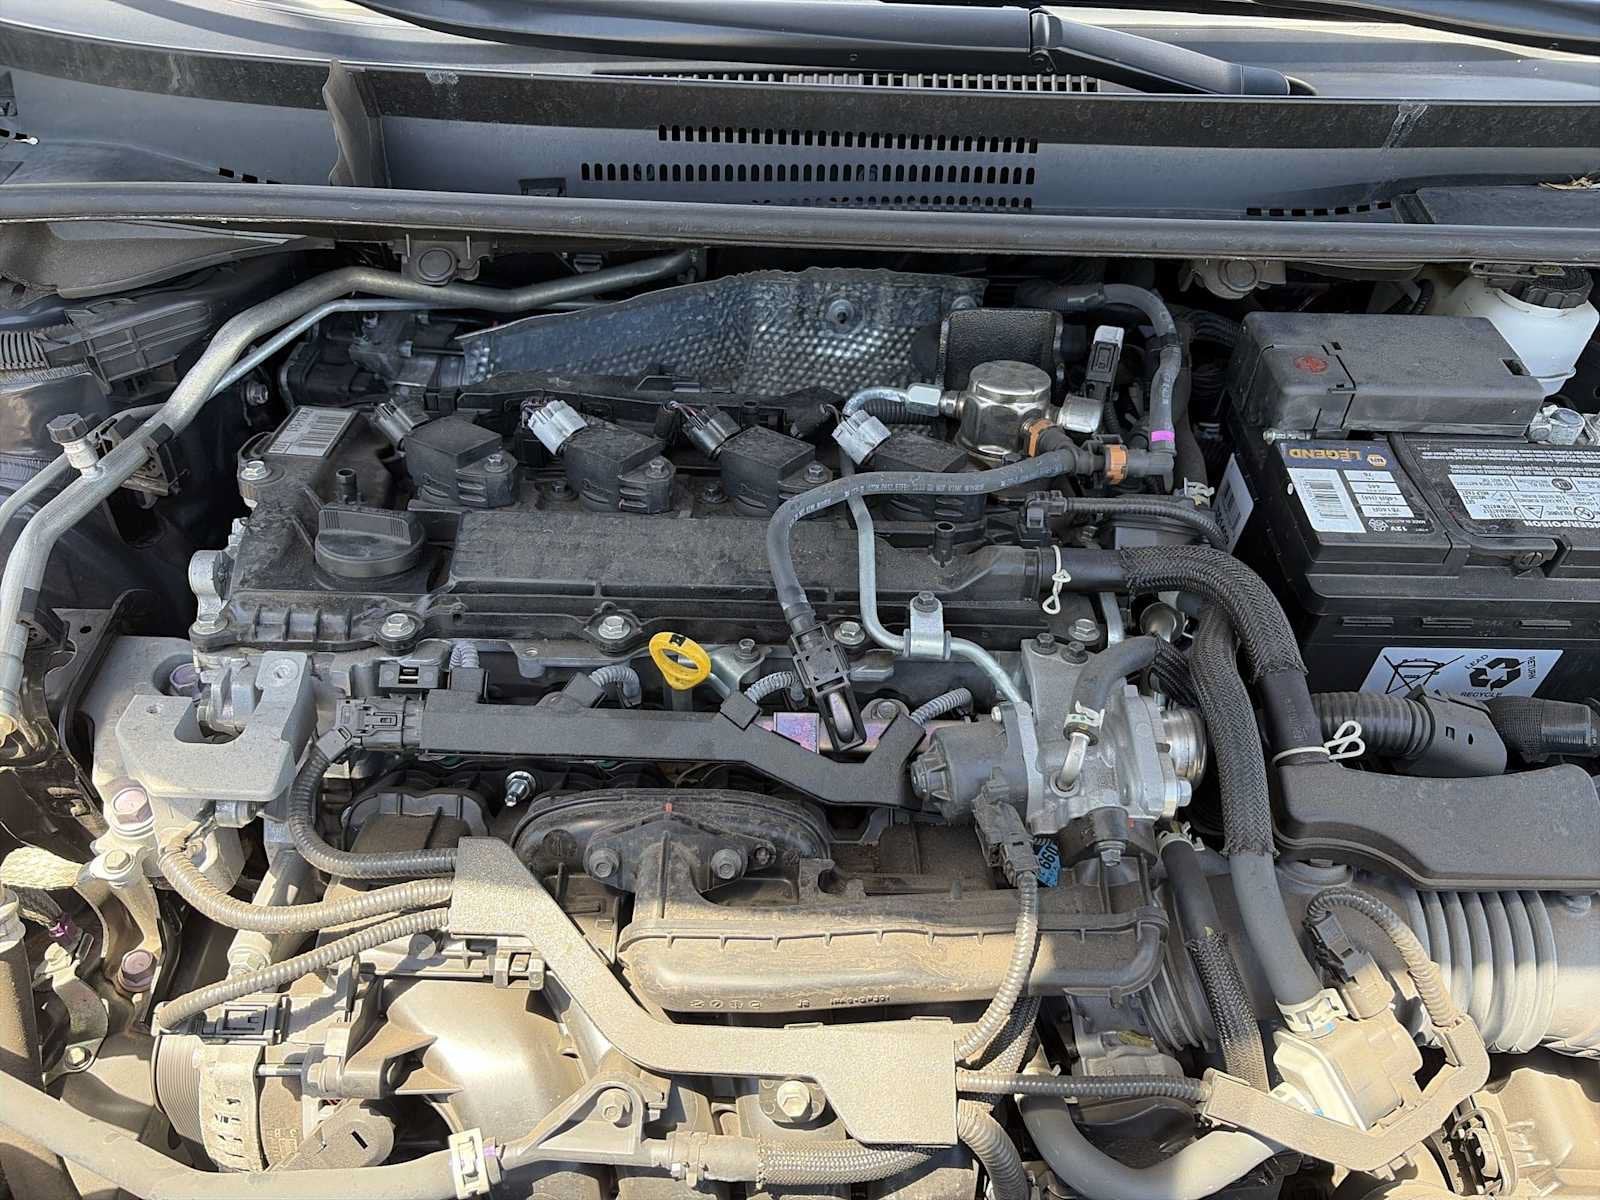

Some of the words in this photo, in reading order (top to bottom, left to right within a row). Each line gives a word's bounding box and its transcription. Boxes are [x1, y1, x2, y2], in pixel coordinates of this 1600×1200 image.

[1289, 448, 1361, 460] LEGEND
[1464, 655, 1489, 669] LEAD
[1528, 656, 1536, 679] RETURN
